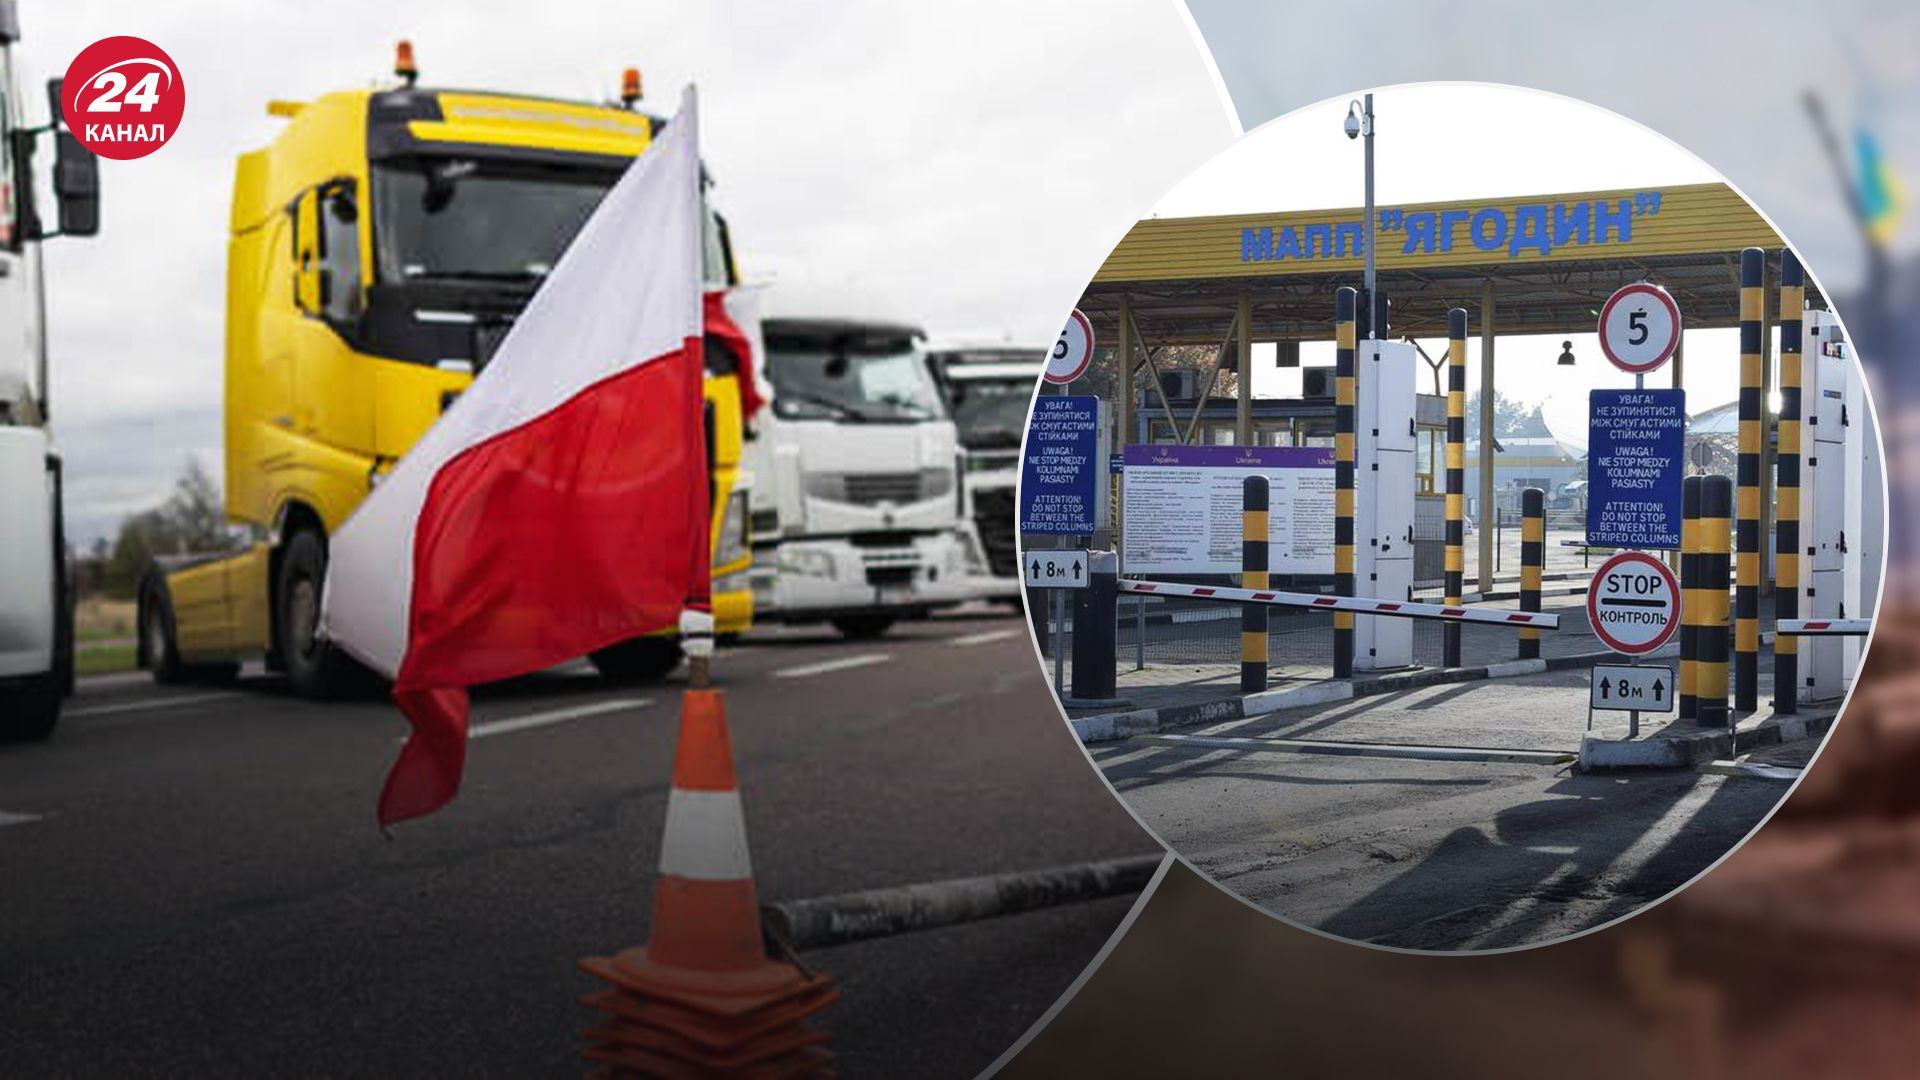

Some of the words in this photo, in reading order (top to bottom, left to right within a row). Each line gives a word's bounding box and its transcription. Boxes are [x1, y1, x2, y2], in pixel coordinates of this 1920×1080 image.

[1241, 223, 1363, 262] МАПП
[1629, 311, 1648, 345] 5
[1619, 394, 1654, 404] УВАГА!
[1045, 402, 1073, 410] УВАГА!
[1596, 406, 1609, 416] НЕ
[1610, 406, 1676, 416] ЗУПИНЯТИСЯ
[1039, 412, 1090, 420] ЗУПИНЯТИСЯ
[1041, 422, 1095, 430] СМУГАСТИМИ
[1590, 418, 1612, 428] МІЖ
[1613, 418, 1681, 428] СМУГАСТИМИ
[1038, 431, 1079, 440] СТІЙКАМИ
[1610, 428, 1660, 440] СТІЙКАМИ
[1029, 456, 1040, 464] NIE
[1041, 456, 1060, 464] STOP
[1598, 457, 1611, 466] NIE
[1613, 457, 1635, 467] STOP
[1637, 458, 1670, 468] MIĘDZY
[1036, 466, 1079, 474] KOLUMNAMI
[1607, 468, 1660, 478] KOLUMNAMI
[1040, 475, 1074, 483] PASIASTY
[1612, 479, 1655, 488] PASIASTY
[1035, 495, 1082, 503] ATTENTION!
[1032, 504, 1043, 512] DO
[1045, 504, 1058, 512] NOT
[1063, 504, 1084, 513] STOP
[1606, 502, 1663, 512] ATTENTION!
[1030, 513, 1066, 521] BETWEEN
[1070, 514, 1084, 522] THE
[1602, 512, 1615, 521] DO
[1618, 512, 1637, 521] NOT
[1640, 513, 1666, 523] STOP
[1022, 522, 1053, 530] STRIPED
[1055, 522, 1094, 532] COLUMNS
[1600, 522, 1645, 532] BETWEEN
[1648, 523, 1668, 533] THE
[1589, 532, 1628, 542] STRIPED
[1630, 533, 1679, 544] COLUMNS
[1607, 574, 1662, 594] STOP
[1600, 610, 1668, 625] КОНТРОЛЬ
